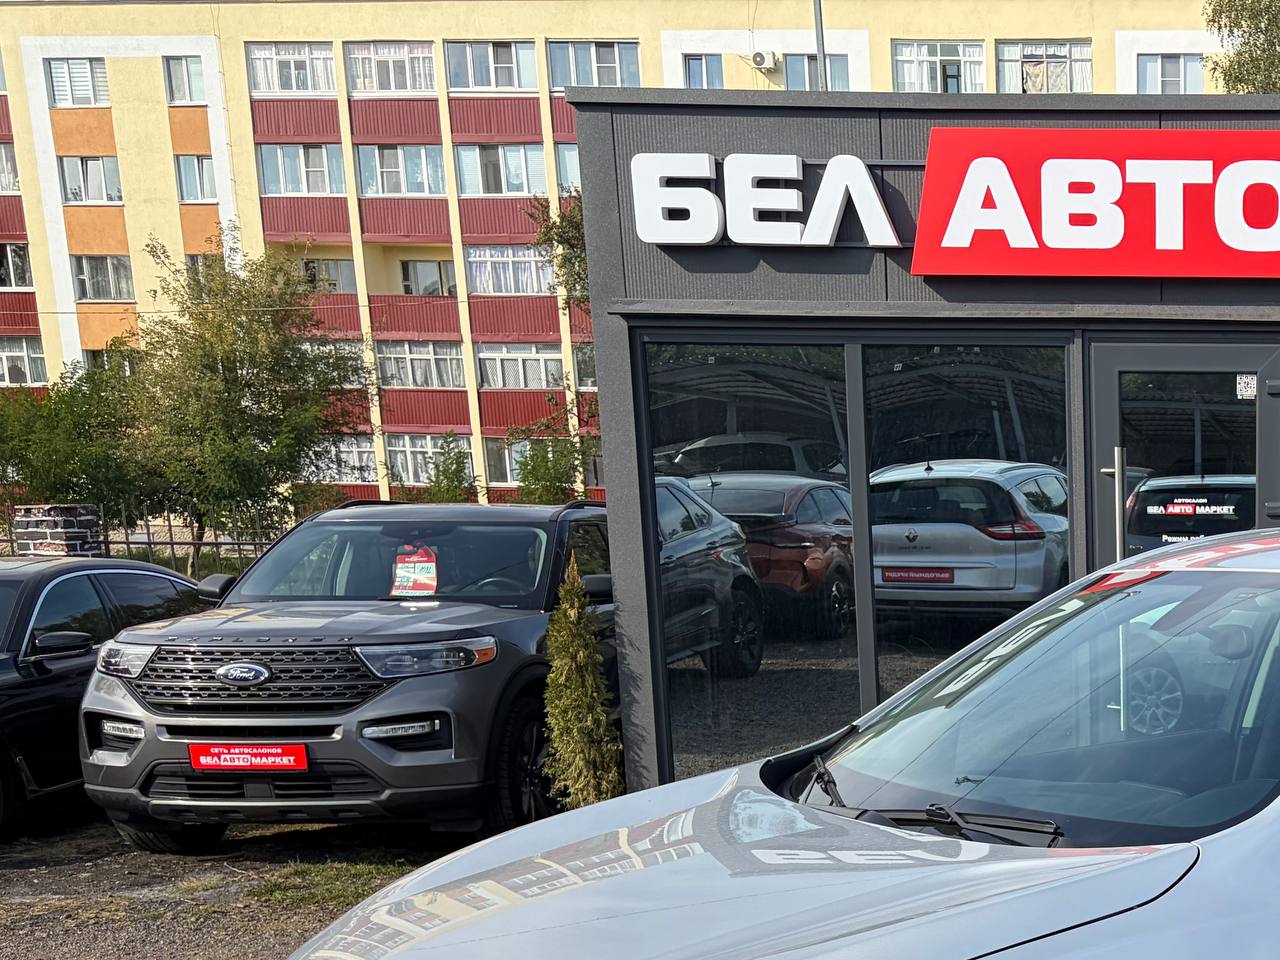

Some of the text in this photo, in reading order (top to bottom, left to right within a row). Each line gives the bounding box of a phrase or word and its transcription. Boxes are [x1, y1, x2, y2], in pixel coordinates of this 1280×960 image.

[631, 152, 900, 247] БЕЛ
[1146, 505, 1236, 515] БЕЛ АВТО МАРКЕТ
[228, 667, 256, 681] Ford
[199, 755, 296, 765] БЕЛ АВТО МАРКЕТ
